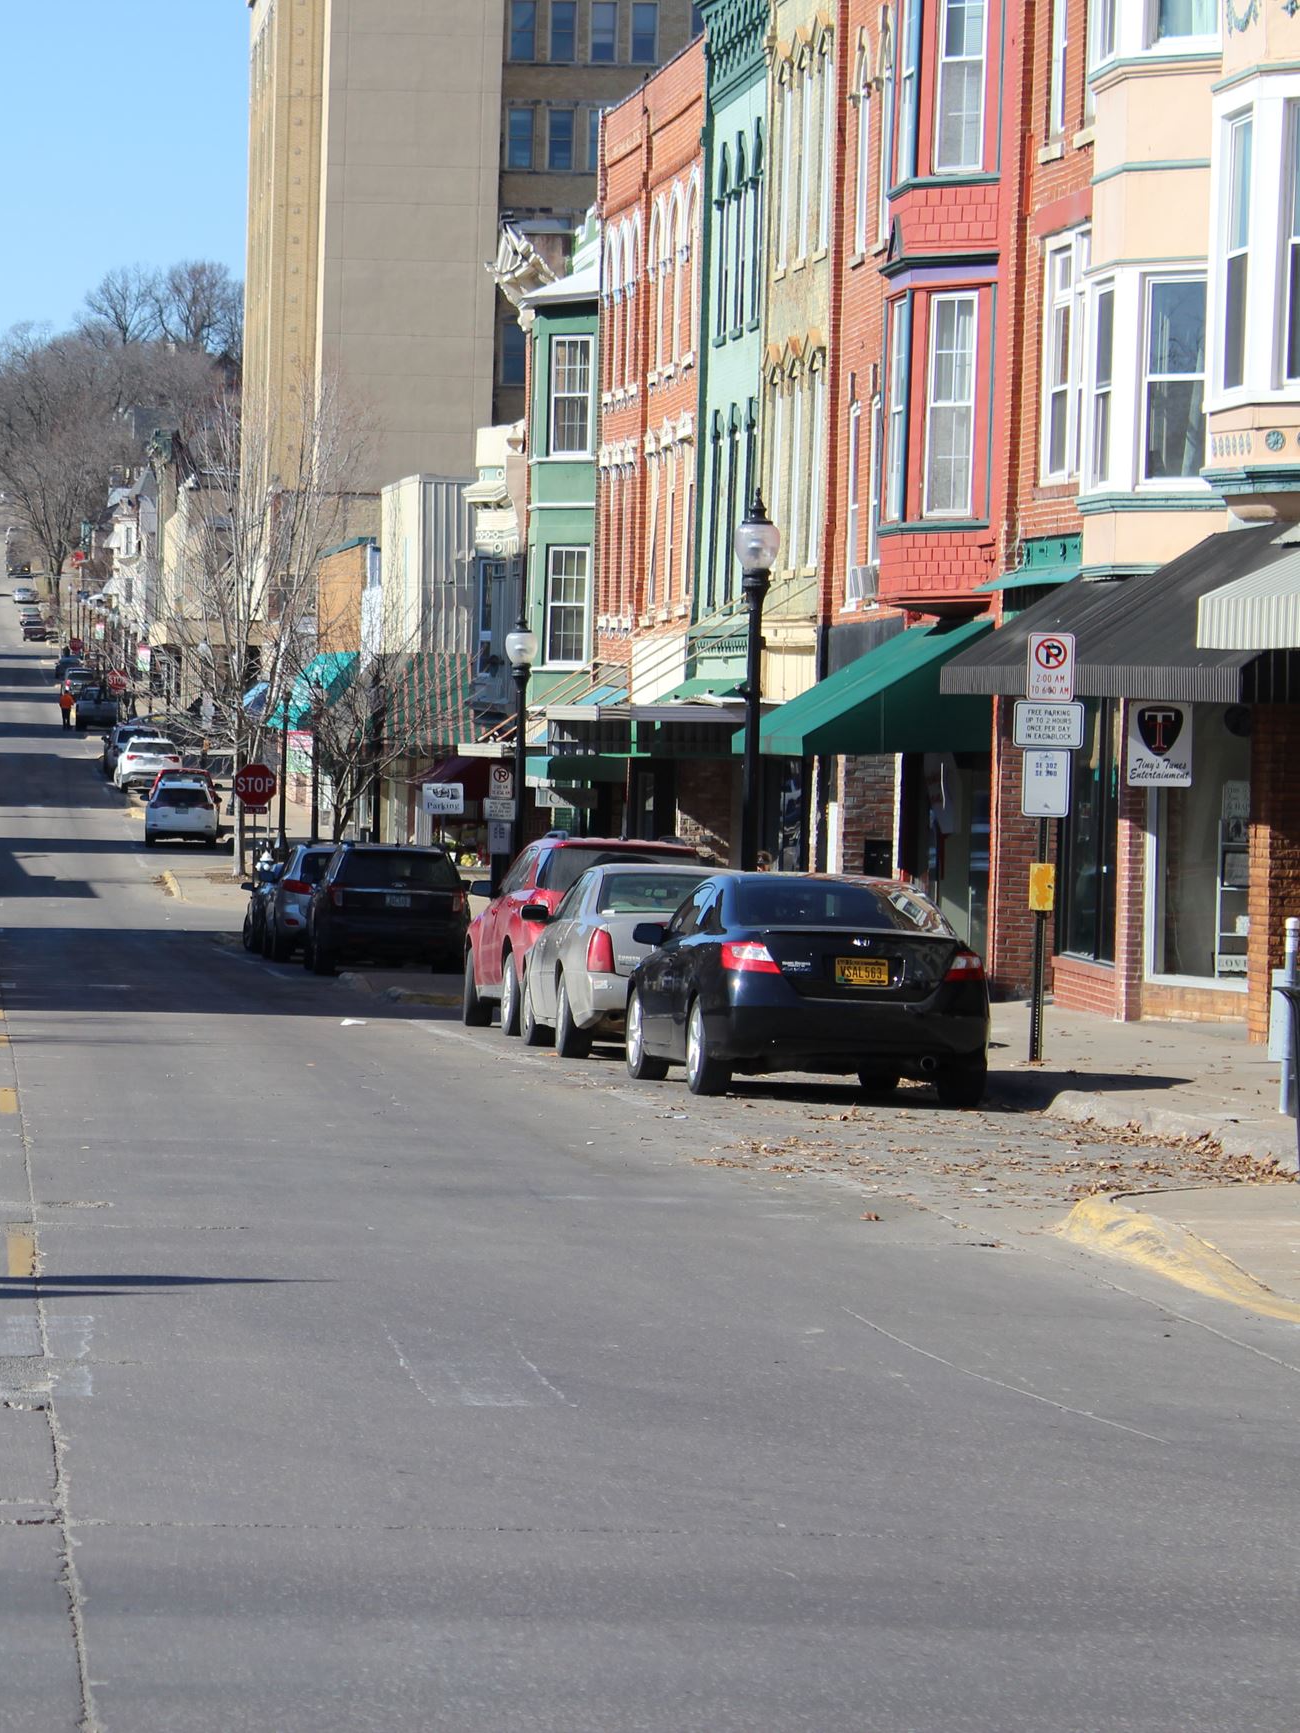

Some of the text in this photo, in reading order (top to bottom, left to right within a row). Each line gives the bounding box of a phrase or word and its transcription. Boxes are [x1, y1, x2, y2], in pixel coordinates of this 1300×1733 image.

[1036, 674, 1065, 684] 2:00 AM
[1059, 687, 1069, 695] AM
[1044, 710, 1071, 718] PARKING
[1135, 758, 1187, 771] Tiny's Tunes
[1129, 768, 1190, 780] Entertainment
[237, 777, 275, 793] STOP
[427, 801, 461, 812] Parking
